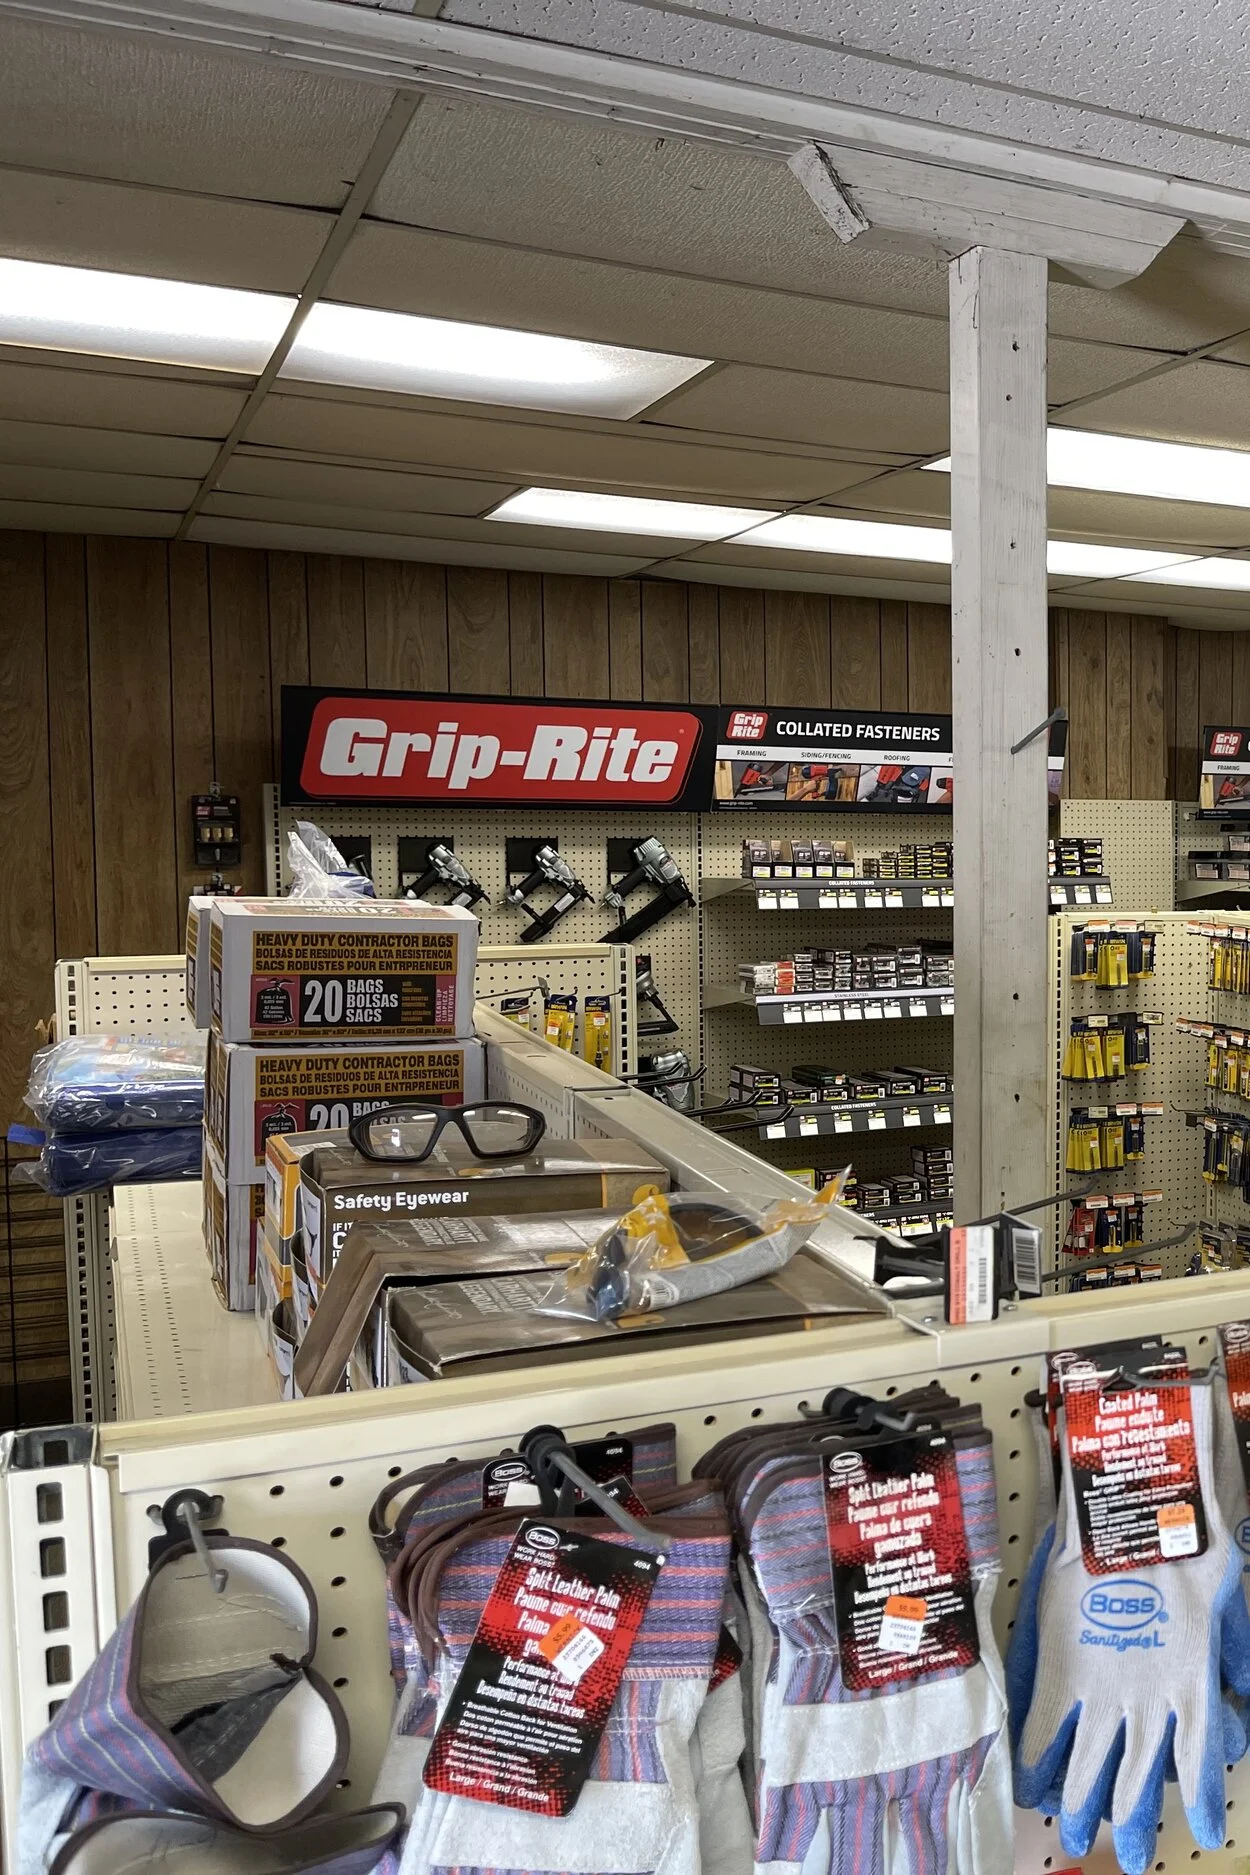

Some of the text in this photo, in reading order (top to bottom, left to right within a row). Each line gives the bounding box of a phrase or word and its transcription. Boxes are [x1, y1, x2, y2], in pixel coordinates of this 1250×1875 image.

[734, 713, 764, 728] Grip
[732, 726, 760, 738] Rite
[776, 721, 941, 741] COLLATED FASTENERS
[1216, 733, 1238, 745] Grip
[320, 718, 678, 789] Grip-Rite
[801, 752, 852, 760] SIDING/FENCING
[1214, 743, 1236, 754] Rite
[883, 754, 911, 762] ROOFING
[256, 933, 453, 948] HEAVY DUTY CONTRACTOR BAGS
[256, 948, 452, 960] BOLSAS DE RESIDUOS DE ALTA RESISTENCIA
[255, 960, 453, 972] SACS ROBUSTES POUR ENTRPRENEUR
[346, 979, 384, 993] BAGS
[304, 979, 342, 1023] 20
[346, 994, 398, 1008] BOLSAS
[346, 1008, 382, 1023] SACS
[260, 1054, 460, 1073] HEAVY DUTY CONTRACTOR BAGS
[260, 1068, 460, 1085] BOLSAS DE RESIDUOS DE ALTA RESISTENCIA
[260, 1080, 460, 1097] SACS ROBUSTES POUR ENTRPRENEUR
[310, 1103, 350, 1131] 20
[334, 1191, 469, 1211] Safety Eyewear
[332, 1222, 342, 1232] IF
[494, 1466, 523, 1478] BOSS
[528, 1531, 557, 1546] BOSS
[514, 1552, 533, 1562] WEAR
[516, 1545, 536, 1554] WORK
[633, 1559, 652, 1571] 4094
[525, 1567, 621, 1611] Split Leather Palm
[513, 1586, 549, 1613] Paume
[575, 1607, 617, 1631] refendu
[1090, 1594, 1155, 1615] BOSS
[517, 1611, 550, 1635] Palma
[1152, 1630, 1166, 1647] L
[868, 1650, 959, 1679] Large Grand Grande
[560, 1701, 586, 1719] tareas
[450, 1771, 550, 1802] Large Grand Grande
